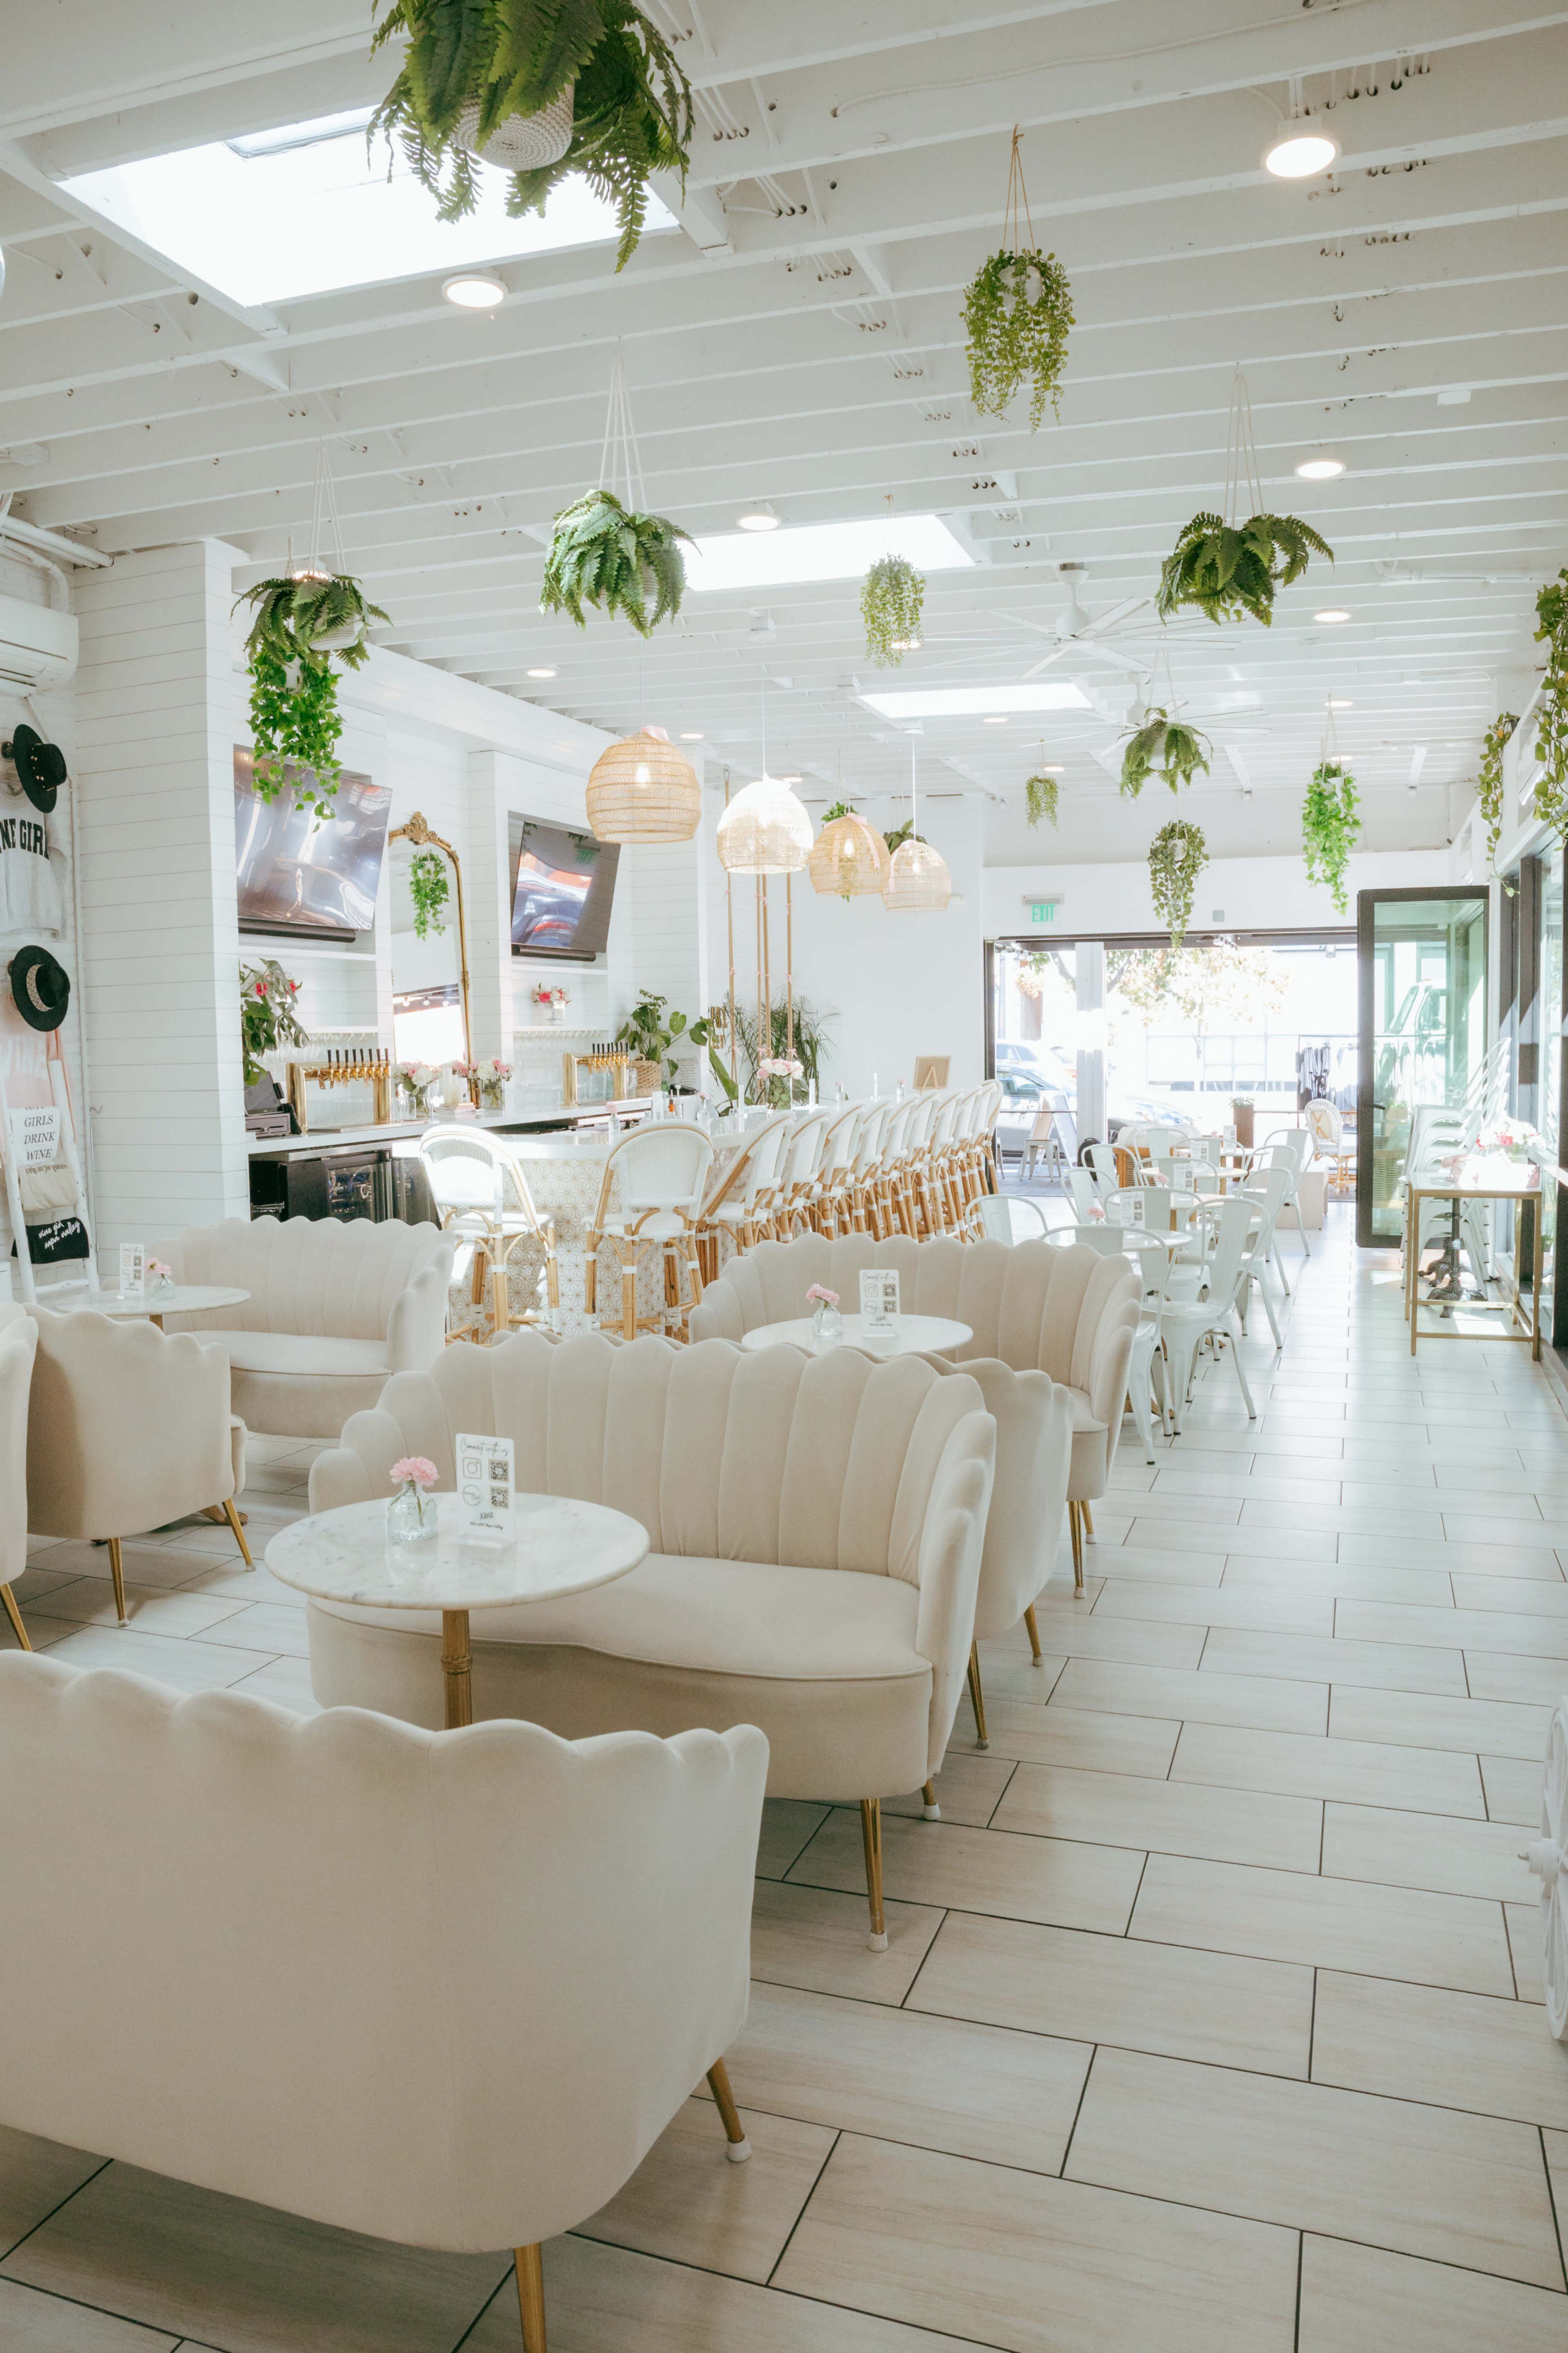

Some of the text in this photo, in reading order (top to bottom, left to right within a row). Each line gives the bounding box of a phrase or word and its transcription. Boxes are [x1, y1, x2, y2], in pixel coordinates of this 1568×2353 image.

[0, 819, 16, 853] NE
[1032, 904, 1054, 922] EXIT
[24, 1115, 53, 1127] GIRLS
[24, 1132, 56, 1144] DRINK
[27, 1149, 53, 1161] WINE
[61, 1221, 80, 1238] valley
[461, 1437, 484, 1456] Connect
